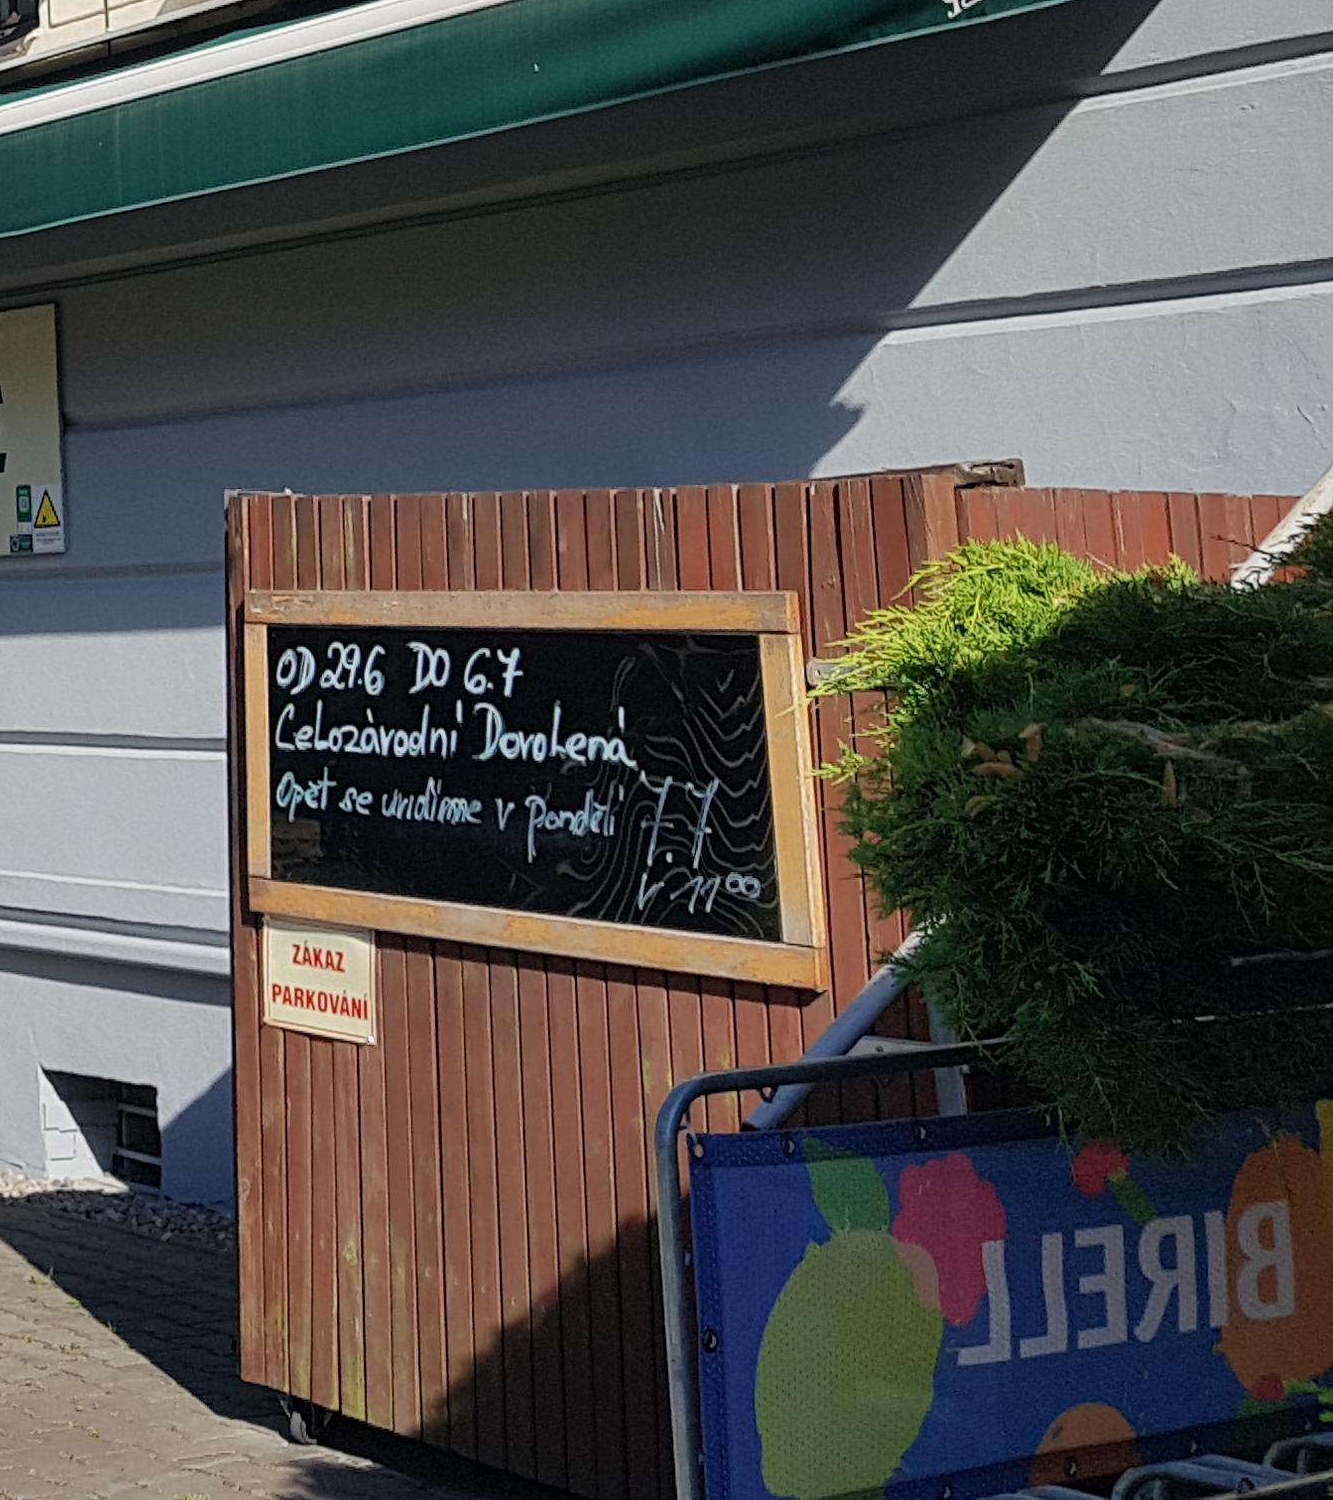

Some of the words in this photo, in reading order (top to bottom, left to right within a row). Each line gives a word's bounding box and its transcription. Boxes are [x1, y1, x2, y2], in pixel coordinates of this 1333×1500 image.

[276, 645, 317, 695] OD
[319, 641, 387, 696] 29.6
[406, 641, 451, 695] DO
[463, 647, 524, 698] 6.7
[338, 786, 374, 815] se
[292, 940, 345, 973] ZÁKAZ
[272, 983, 368, 1020] PARKOVÁNÍ
